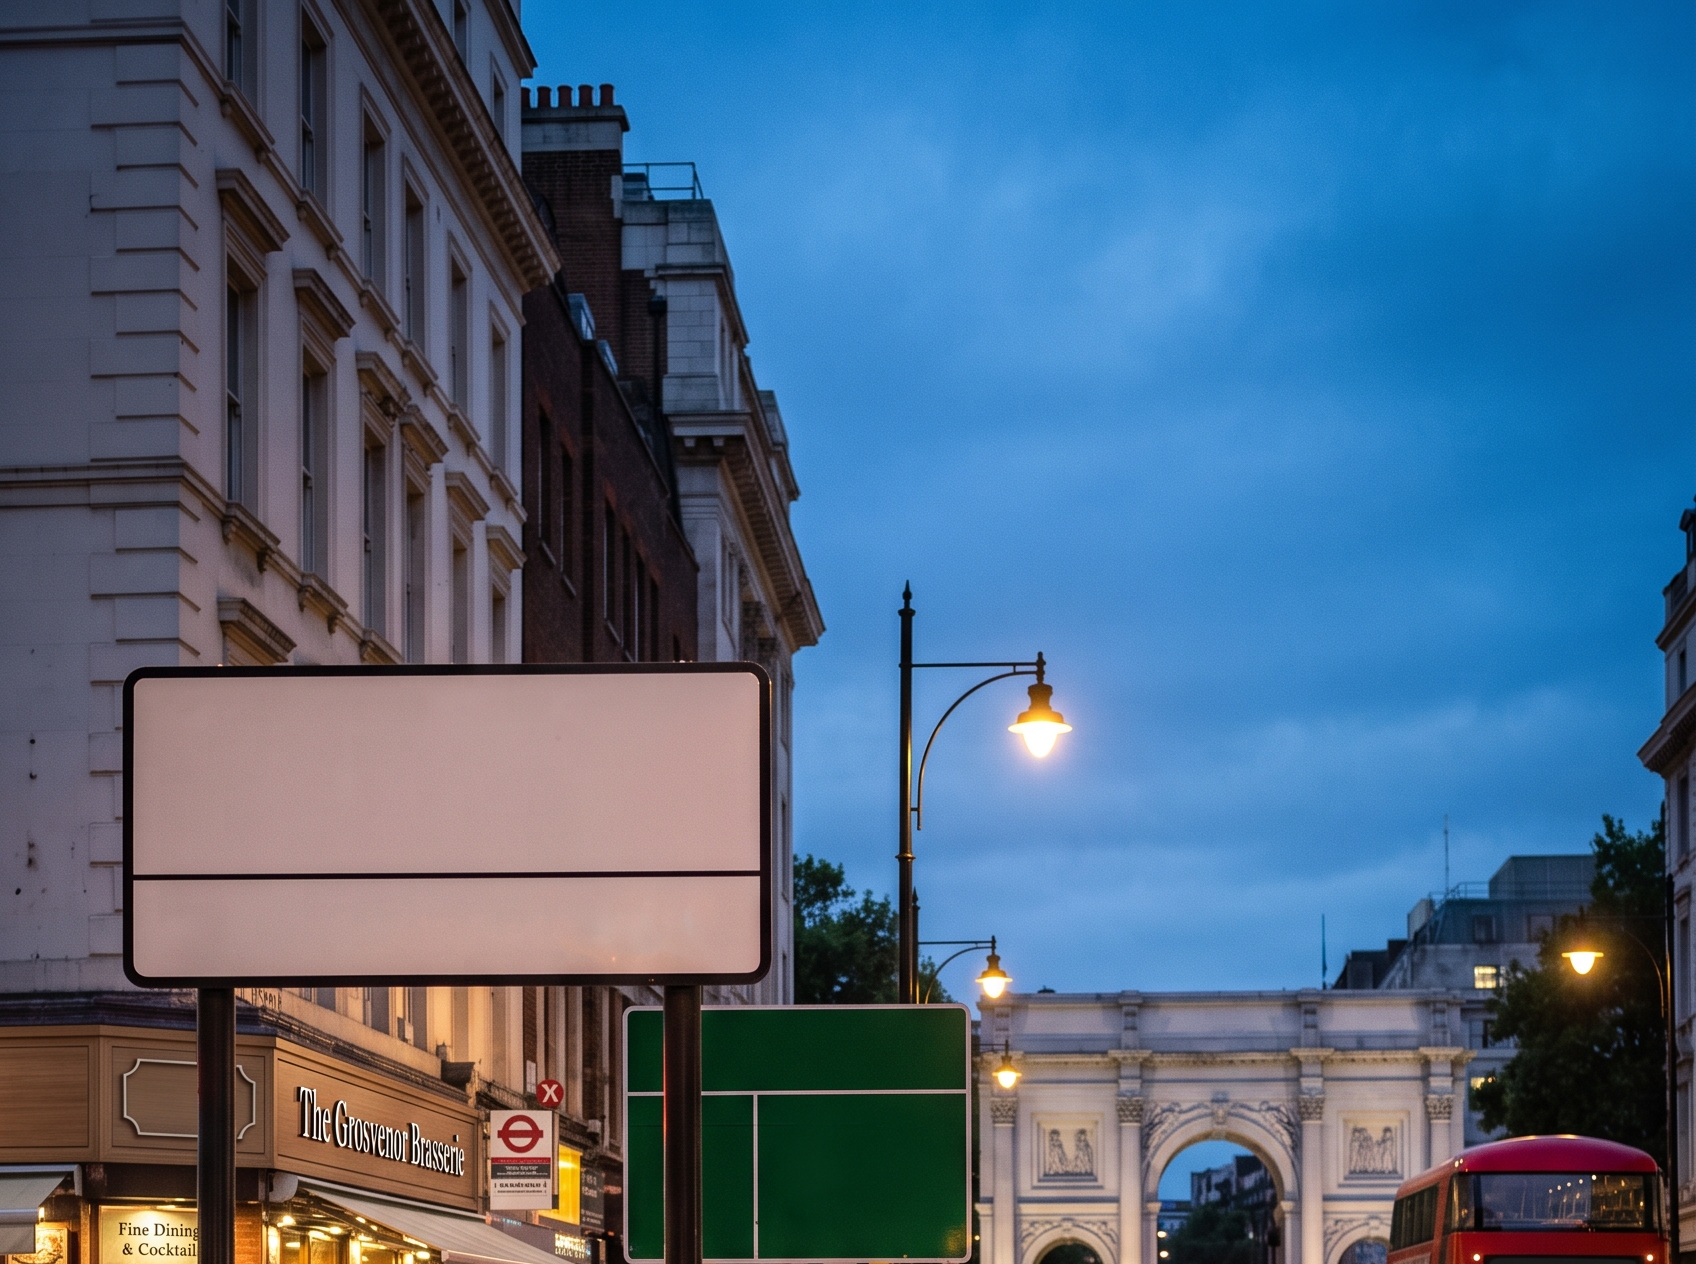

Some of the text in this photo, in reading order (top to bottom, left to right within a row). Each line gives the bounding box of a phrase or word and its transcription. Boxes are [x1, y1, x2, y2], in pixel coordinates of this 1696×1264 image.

[541, 1083, 559, 1103] X
[298, 1086, 465, 1176] The Grosvenor Brasserie
[118, 1222, 198, 1241] Fine Dining
[122, 1242, 133, 1256] &
